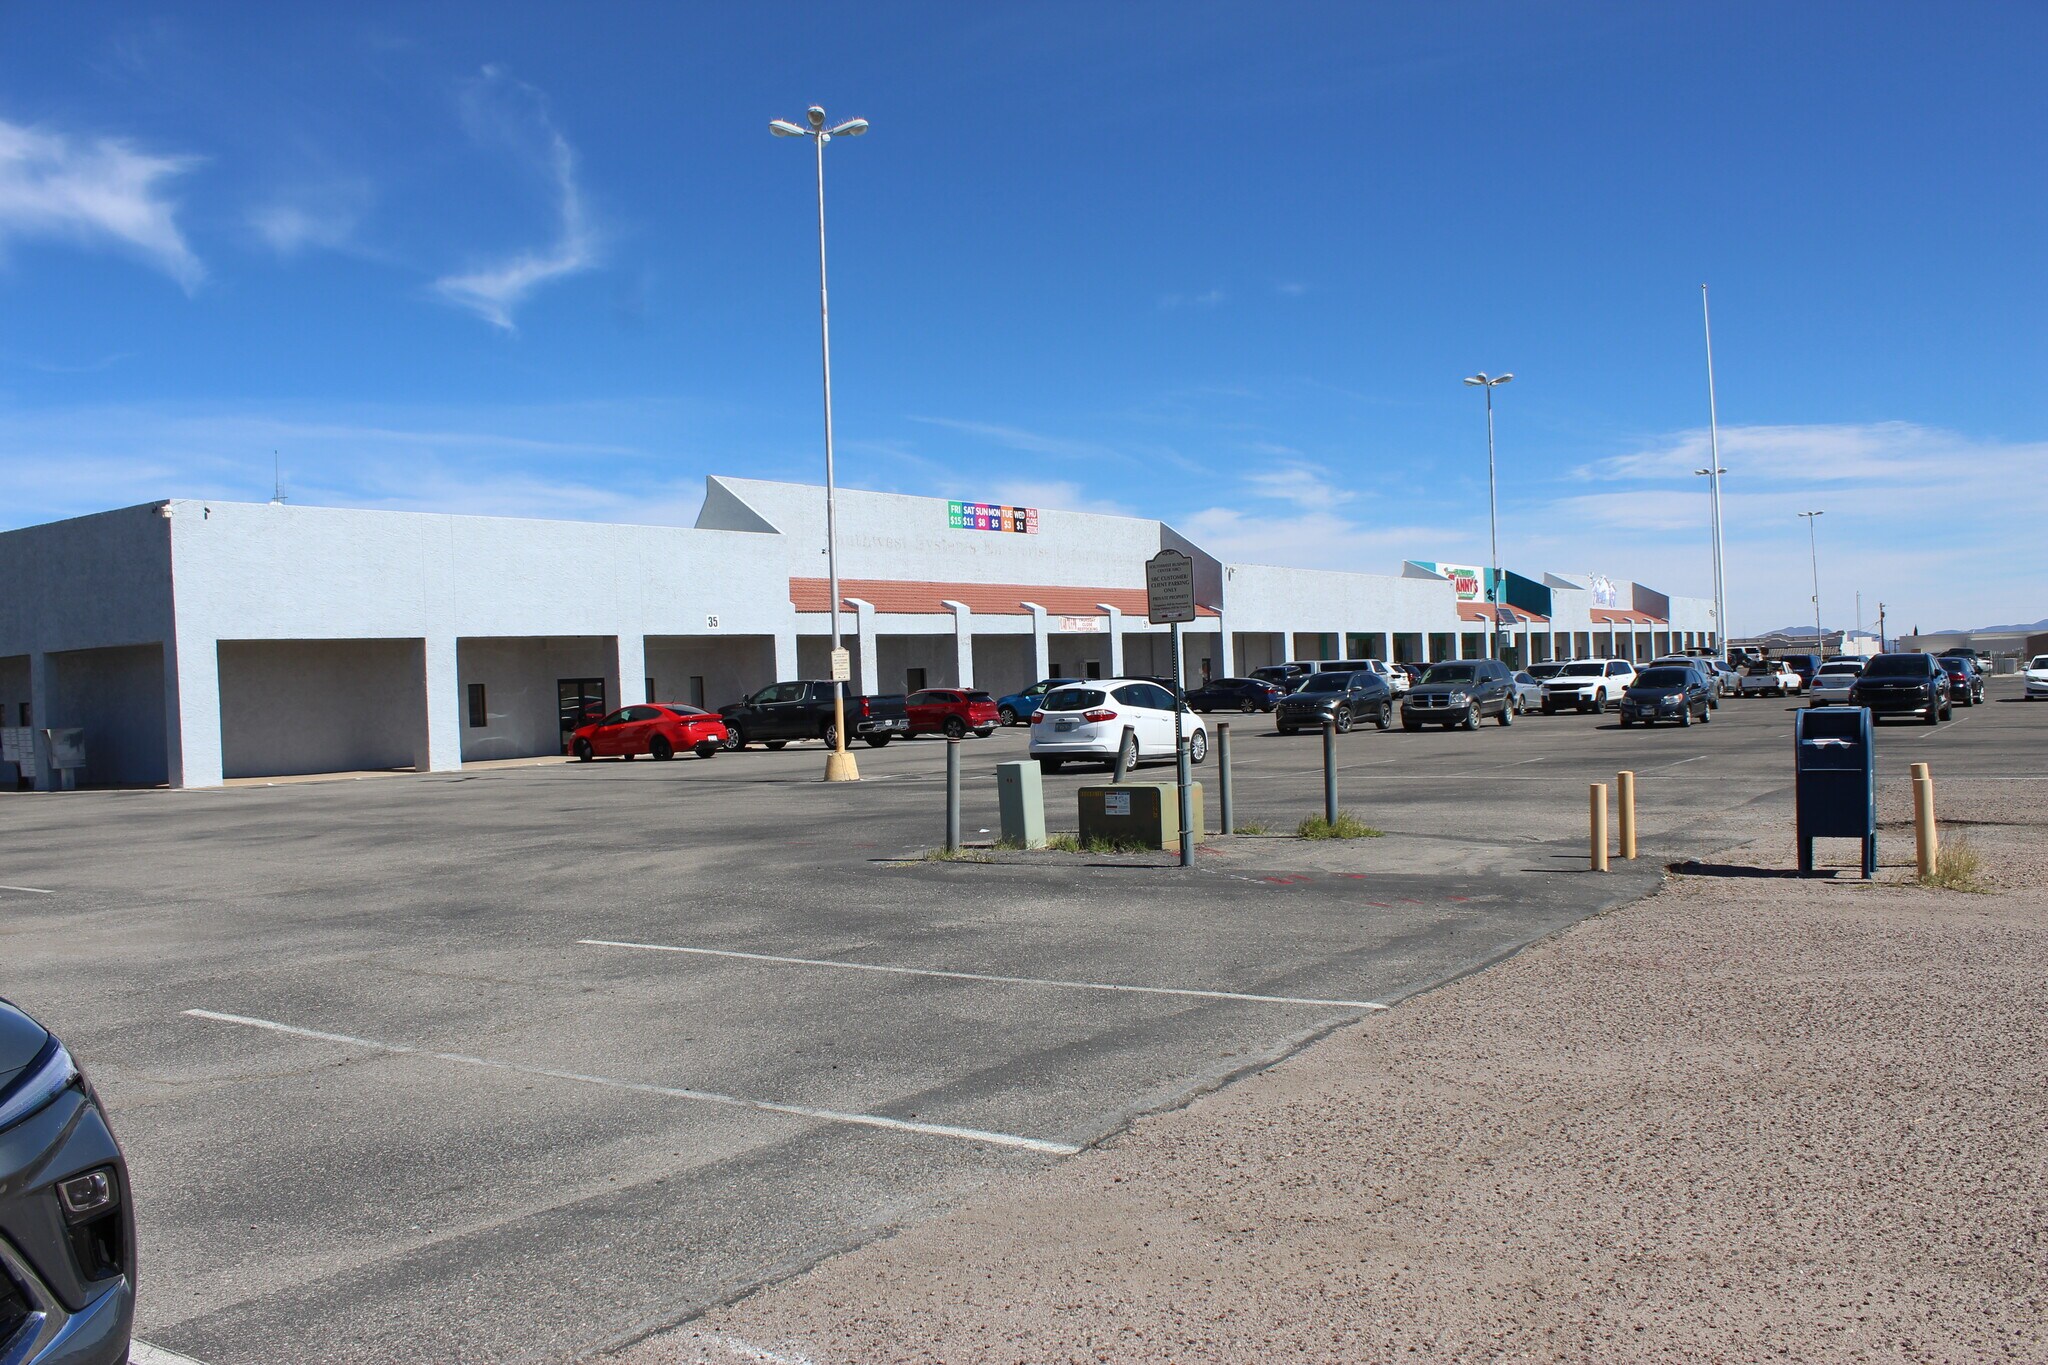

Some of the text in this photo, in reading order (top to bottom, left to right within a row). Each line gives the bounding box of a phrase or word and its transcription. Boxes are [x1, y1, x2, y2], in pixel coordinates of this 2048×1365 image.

[950, 504, 1037, 519] FRI SAT SUN MON TUE WED THU
[950, 516, 962, 525] $15
[963, 517, 974, 526] $11
[978, 518, 986, 527] $8
[991, 519, 999, 528] $5
[1004, 520, 1011, 529] $3
[1016, 521, 1024, 530] $1
[707, 616, 718, 628] 35
